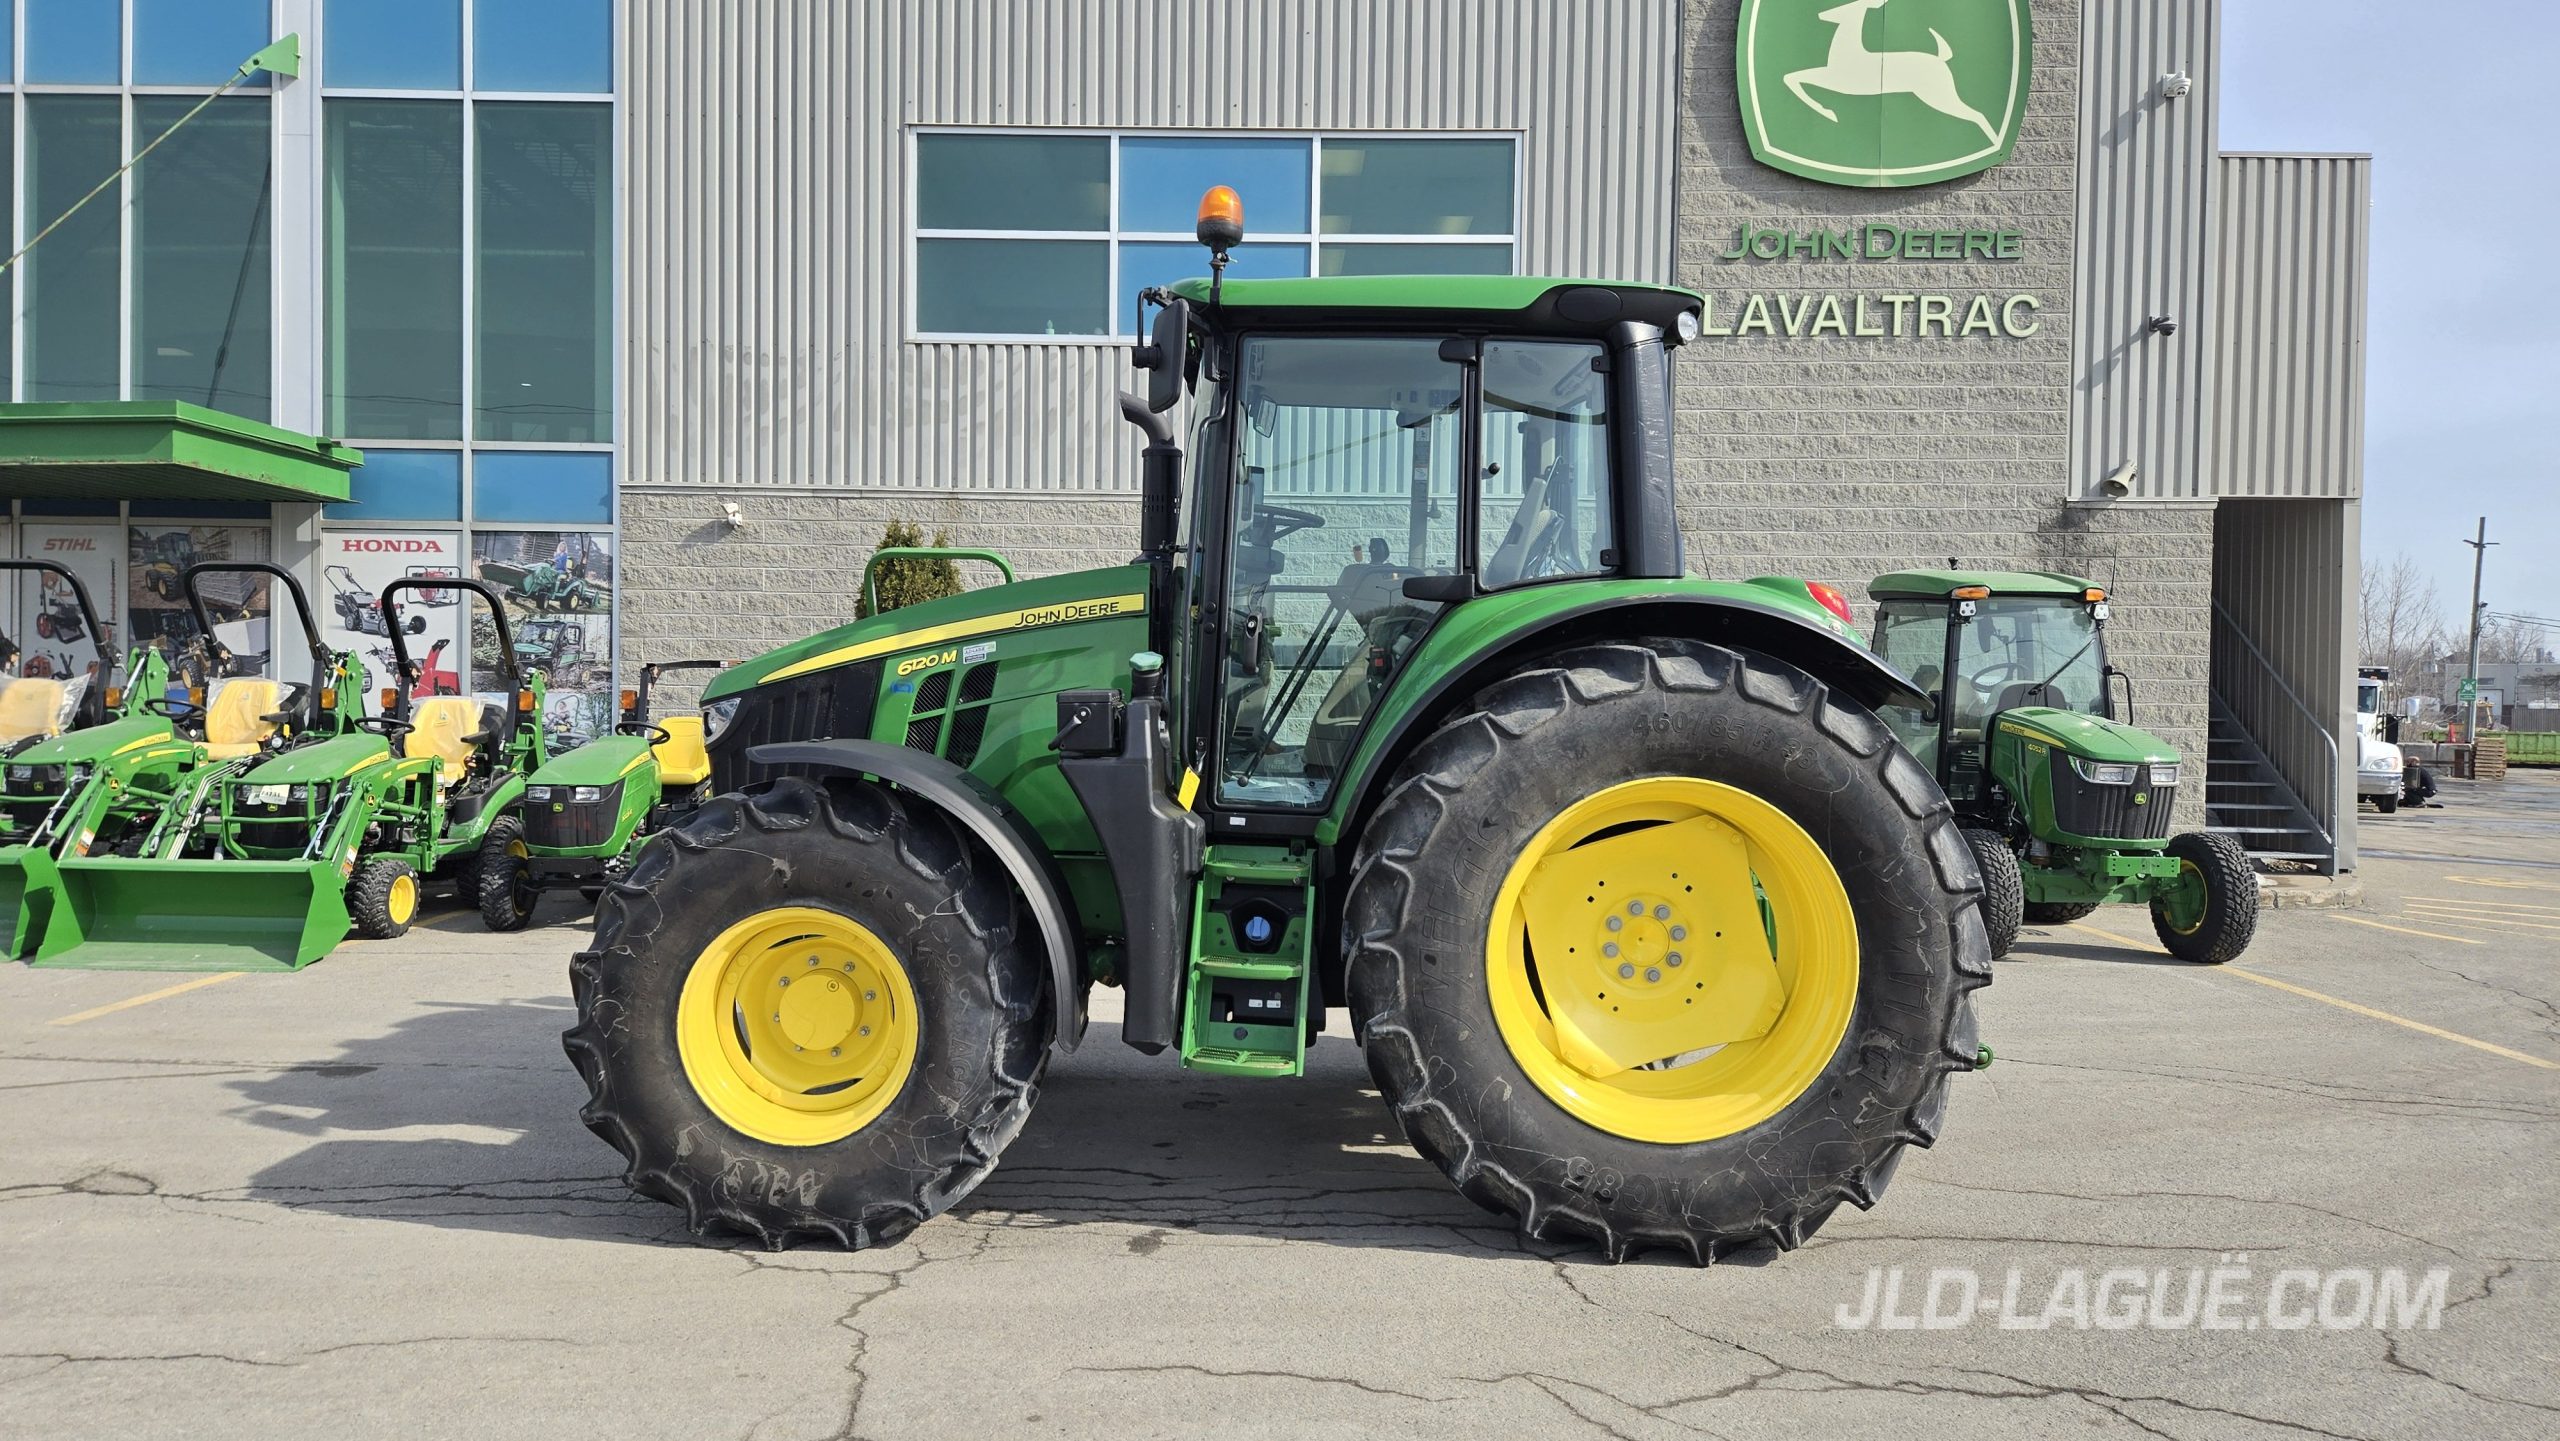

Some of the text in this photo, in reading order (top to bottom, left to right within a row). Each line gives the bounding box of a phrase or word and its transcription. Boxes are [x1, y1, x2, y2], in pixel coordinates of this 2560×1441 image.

[1723, 223, 2024, 259] JOHN DEERE
[1703, 294, 2041, 338] LAVALTRAC
[43, 538, 97, 551] STIHL
[342, 539, 444, 553] HONDA
[1015, 602, 1120, 626] JOHN DEERE
